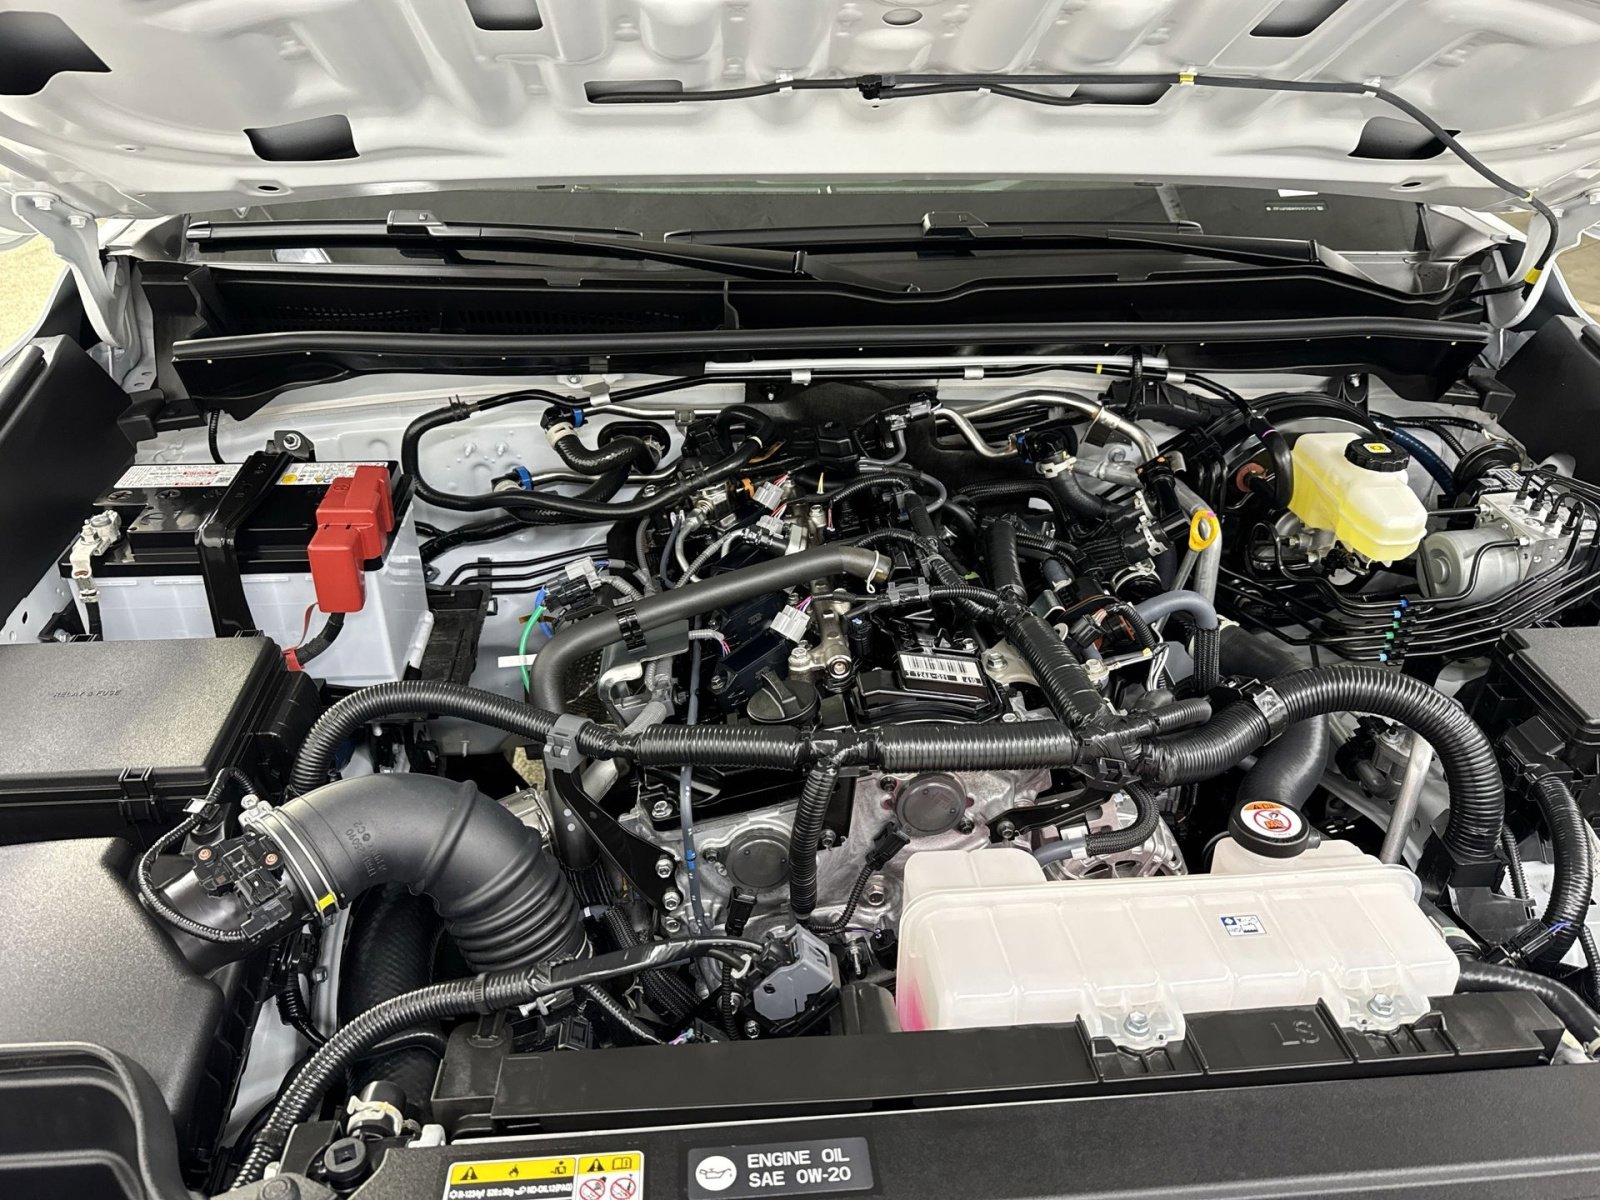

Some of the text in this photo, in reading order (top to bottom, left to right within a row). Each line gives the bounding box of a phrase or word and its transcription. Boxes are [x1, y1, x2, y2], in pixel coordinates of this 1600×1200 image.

[95, 689, 121, 698] FUSE
[747, 1147, 850, 1168] ENGINE OIL
[749, 1166, 851, 1188] SAE 0W-20
